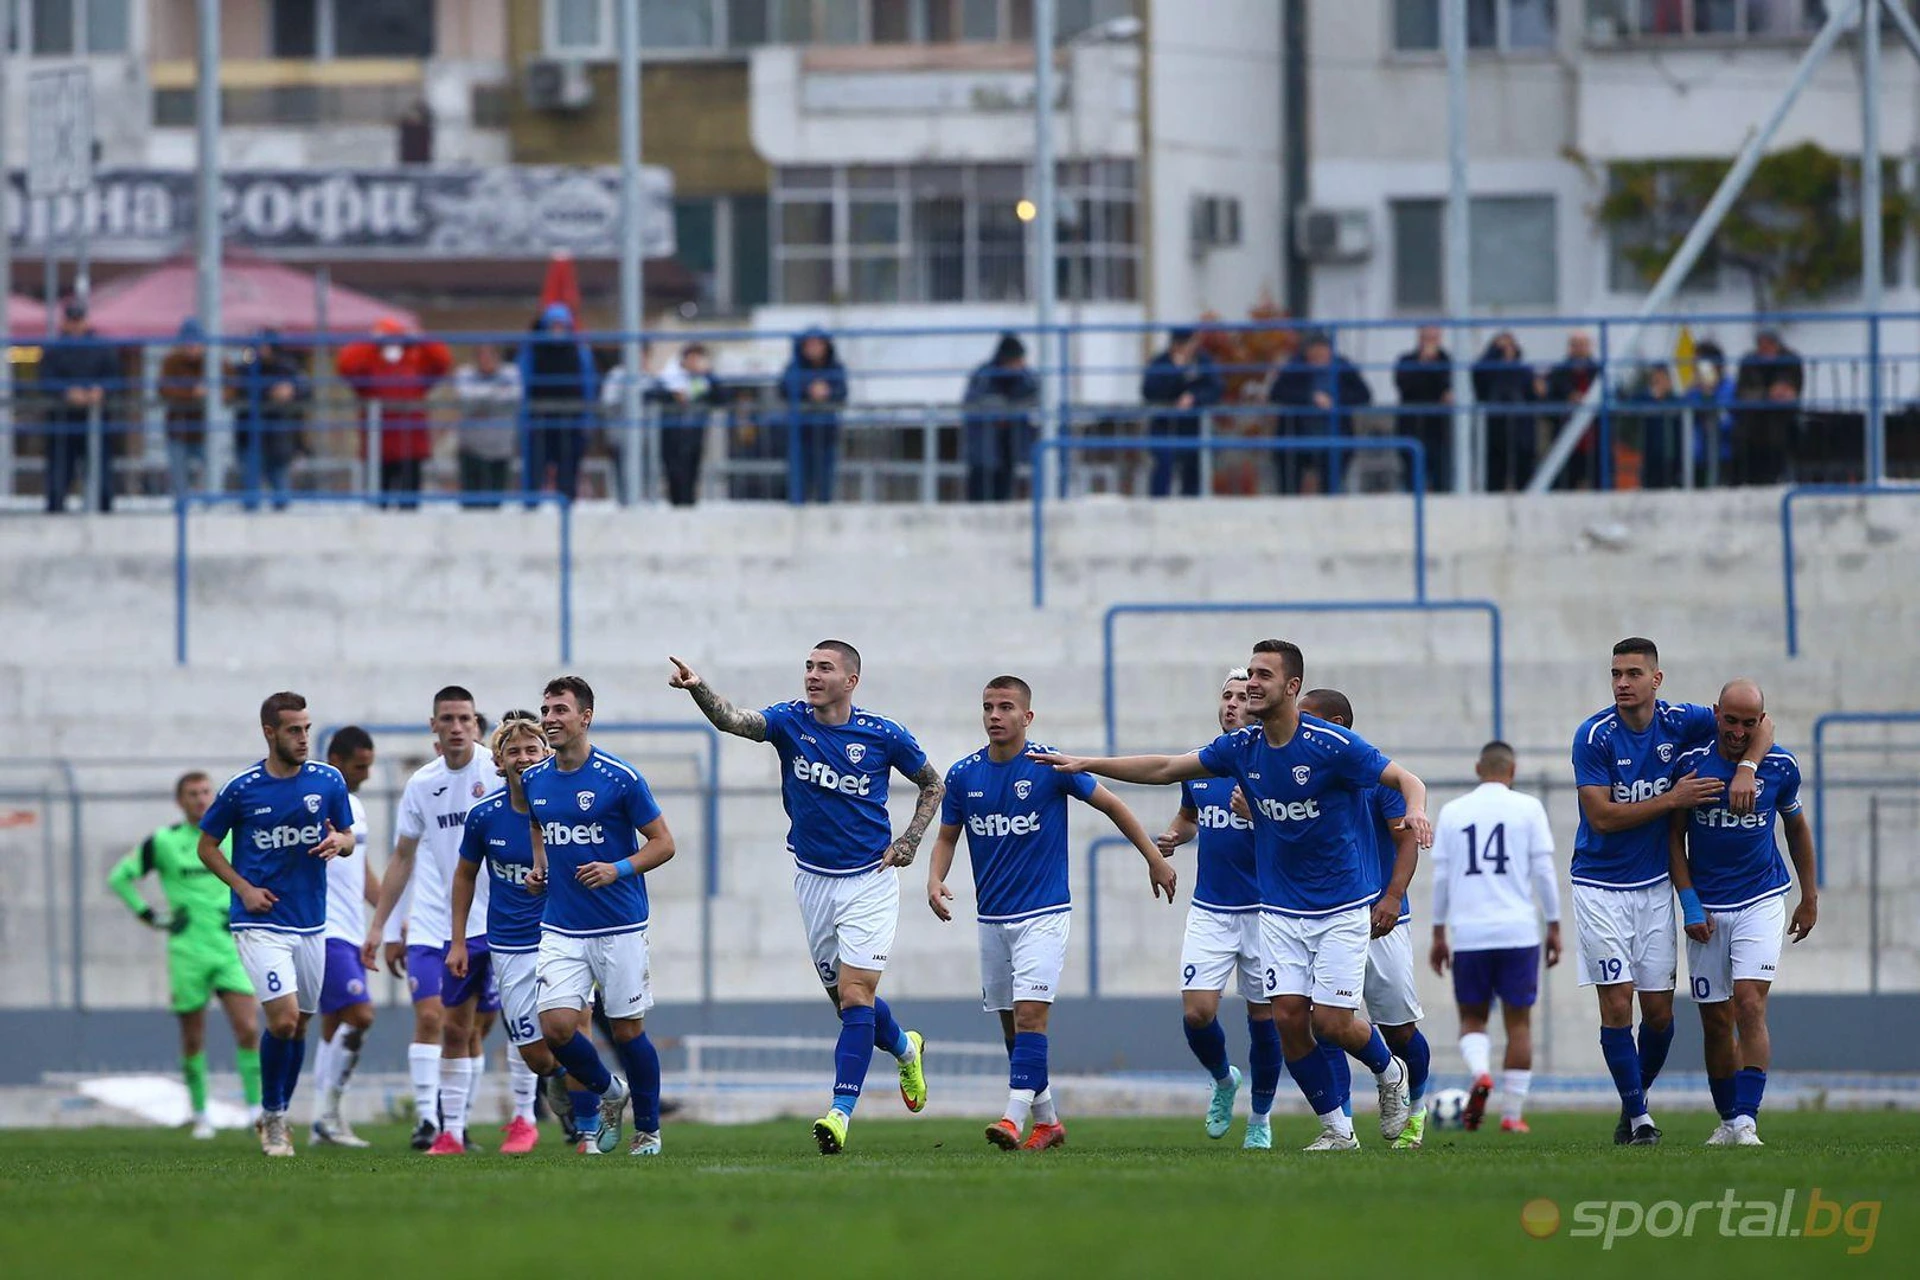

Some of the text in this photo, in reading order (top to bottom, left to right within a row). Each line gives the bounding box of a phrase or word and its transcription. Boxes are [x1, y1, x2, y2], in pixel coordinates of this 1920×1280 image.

[793, 755, 870, 796] efbet
[1613, 777, 1671, 804] efbe
[969, 811, 1041, 837] efbet
[1461, 823, 1510, 876] 14
[491, 860, 548, 885] efb
[267, 971, 282, 992] 8
[1184, 965, 1196, 986] 9
[1266, 968, 1277, 991] 3
[1599, 958, 1622, 982] 19
[1031, 984, 1049, 992] JAKO
[1690, 976, 1710, 999] 10
[834, 1082, 859, 1092] JAKO
